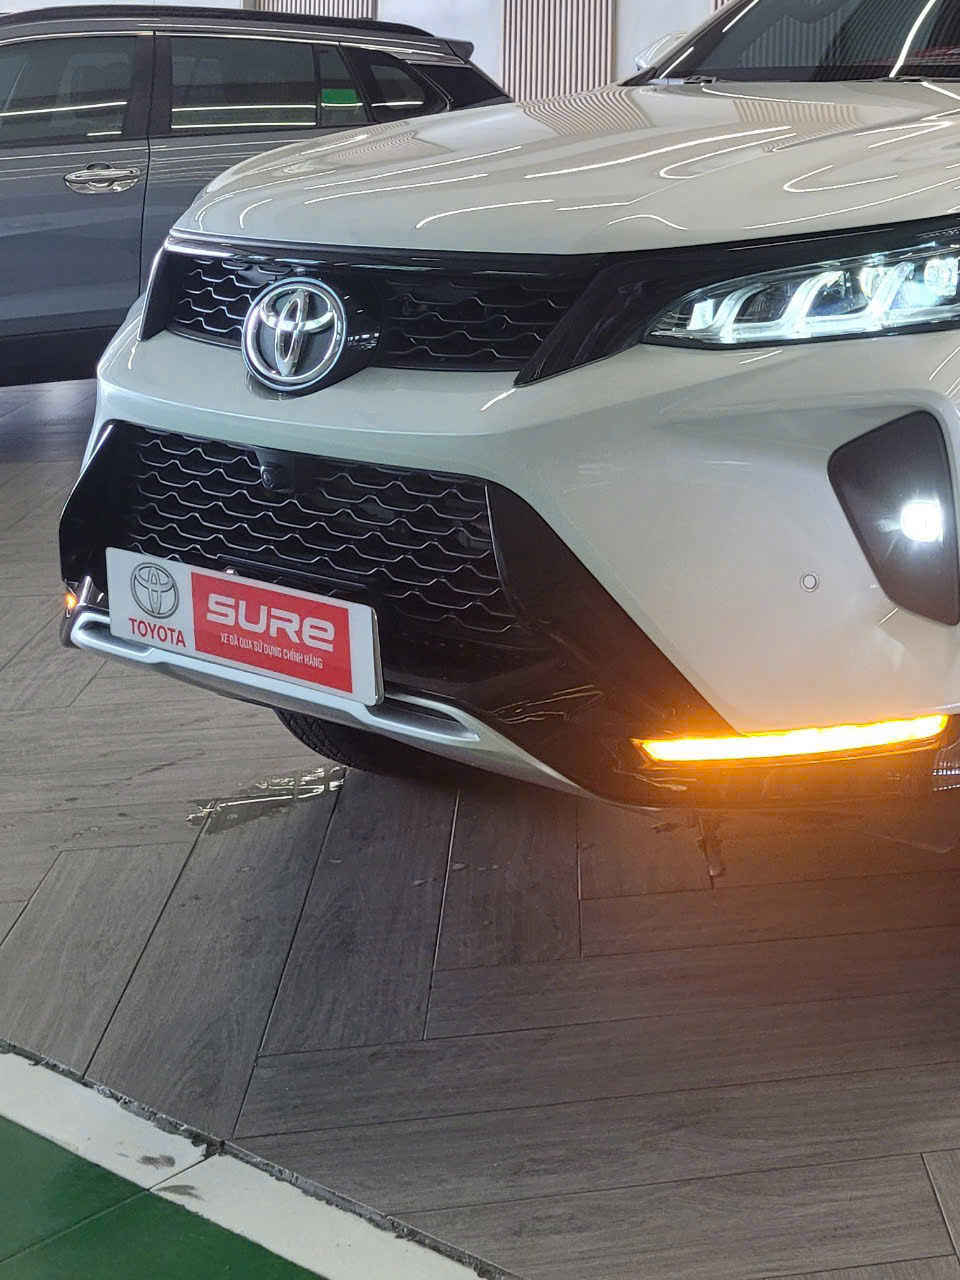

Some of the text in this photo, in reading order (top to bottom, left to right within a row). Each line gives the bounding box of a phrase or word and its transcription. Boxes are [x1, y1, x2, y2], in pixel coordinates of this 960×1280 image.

[128, 617, 186, 648] TOYOTA
[220, 632, 229, 644] XE
[240, 637, 253, 651] QUA
